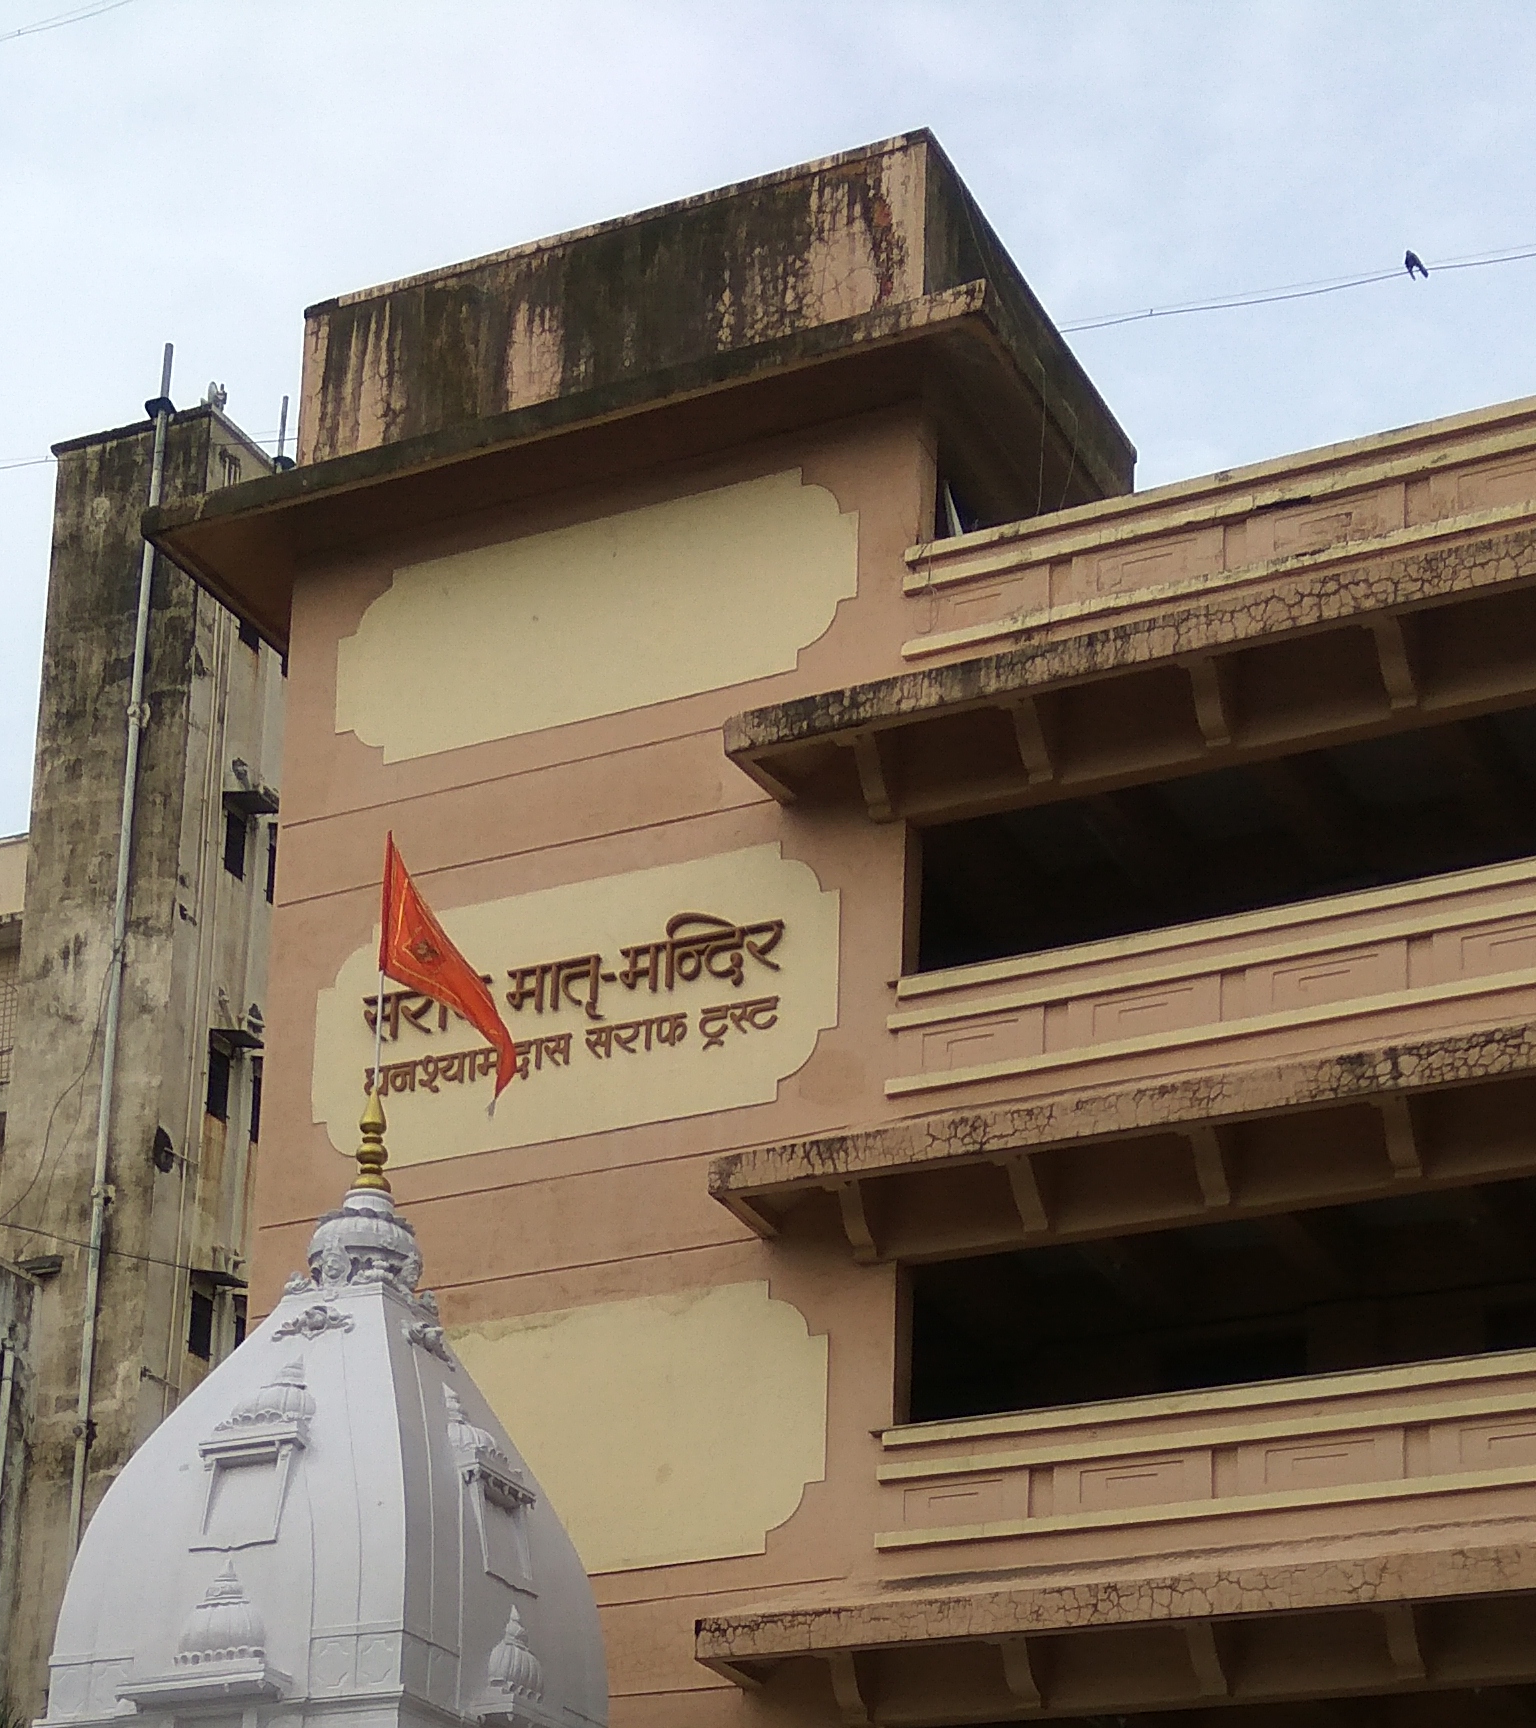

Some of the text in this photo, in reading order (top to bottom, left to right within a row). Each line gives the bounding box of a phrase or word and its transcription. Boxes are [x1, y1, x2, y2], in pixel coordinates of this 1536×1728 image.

[363, 974, 492, 1042] सरा
[585, 1010, 689, 1060] सराफ
[699, 995, 782, 1050] ट्रस्ट
